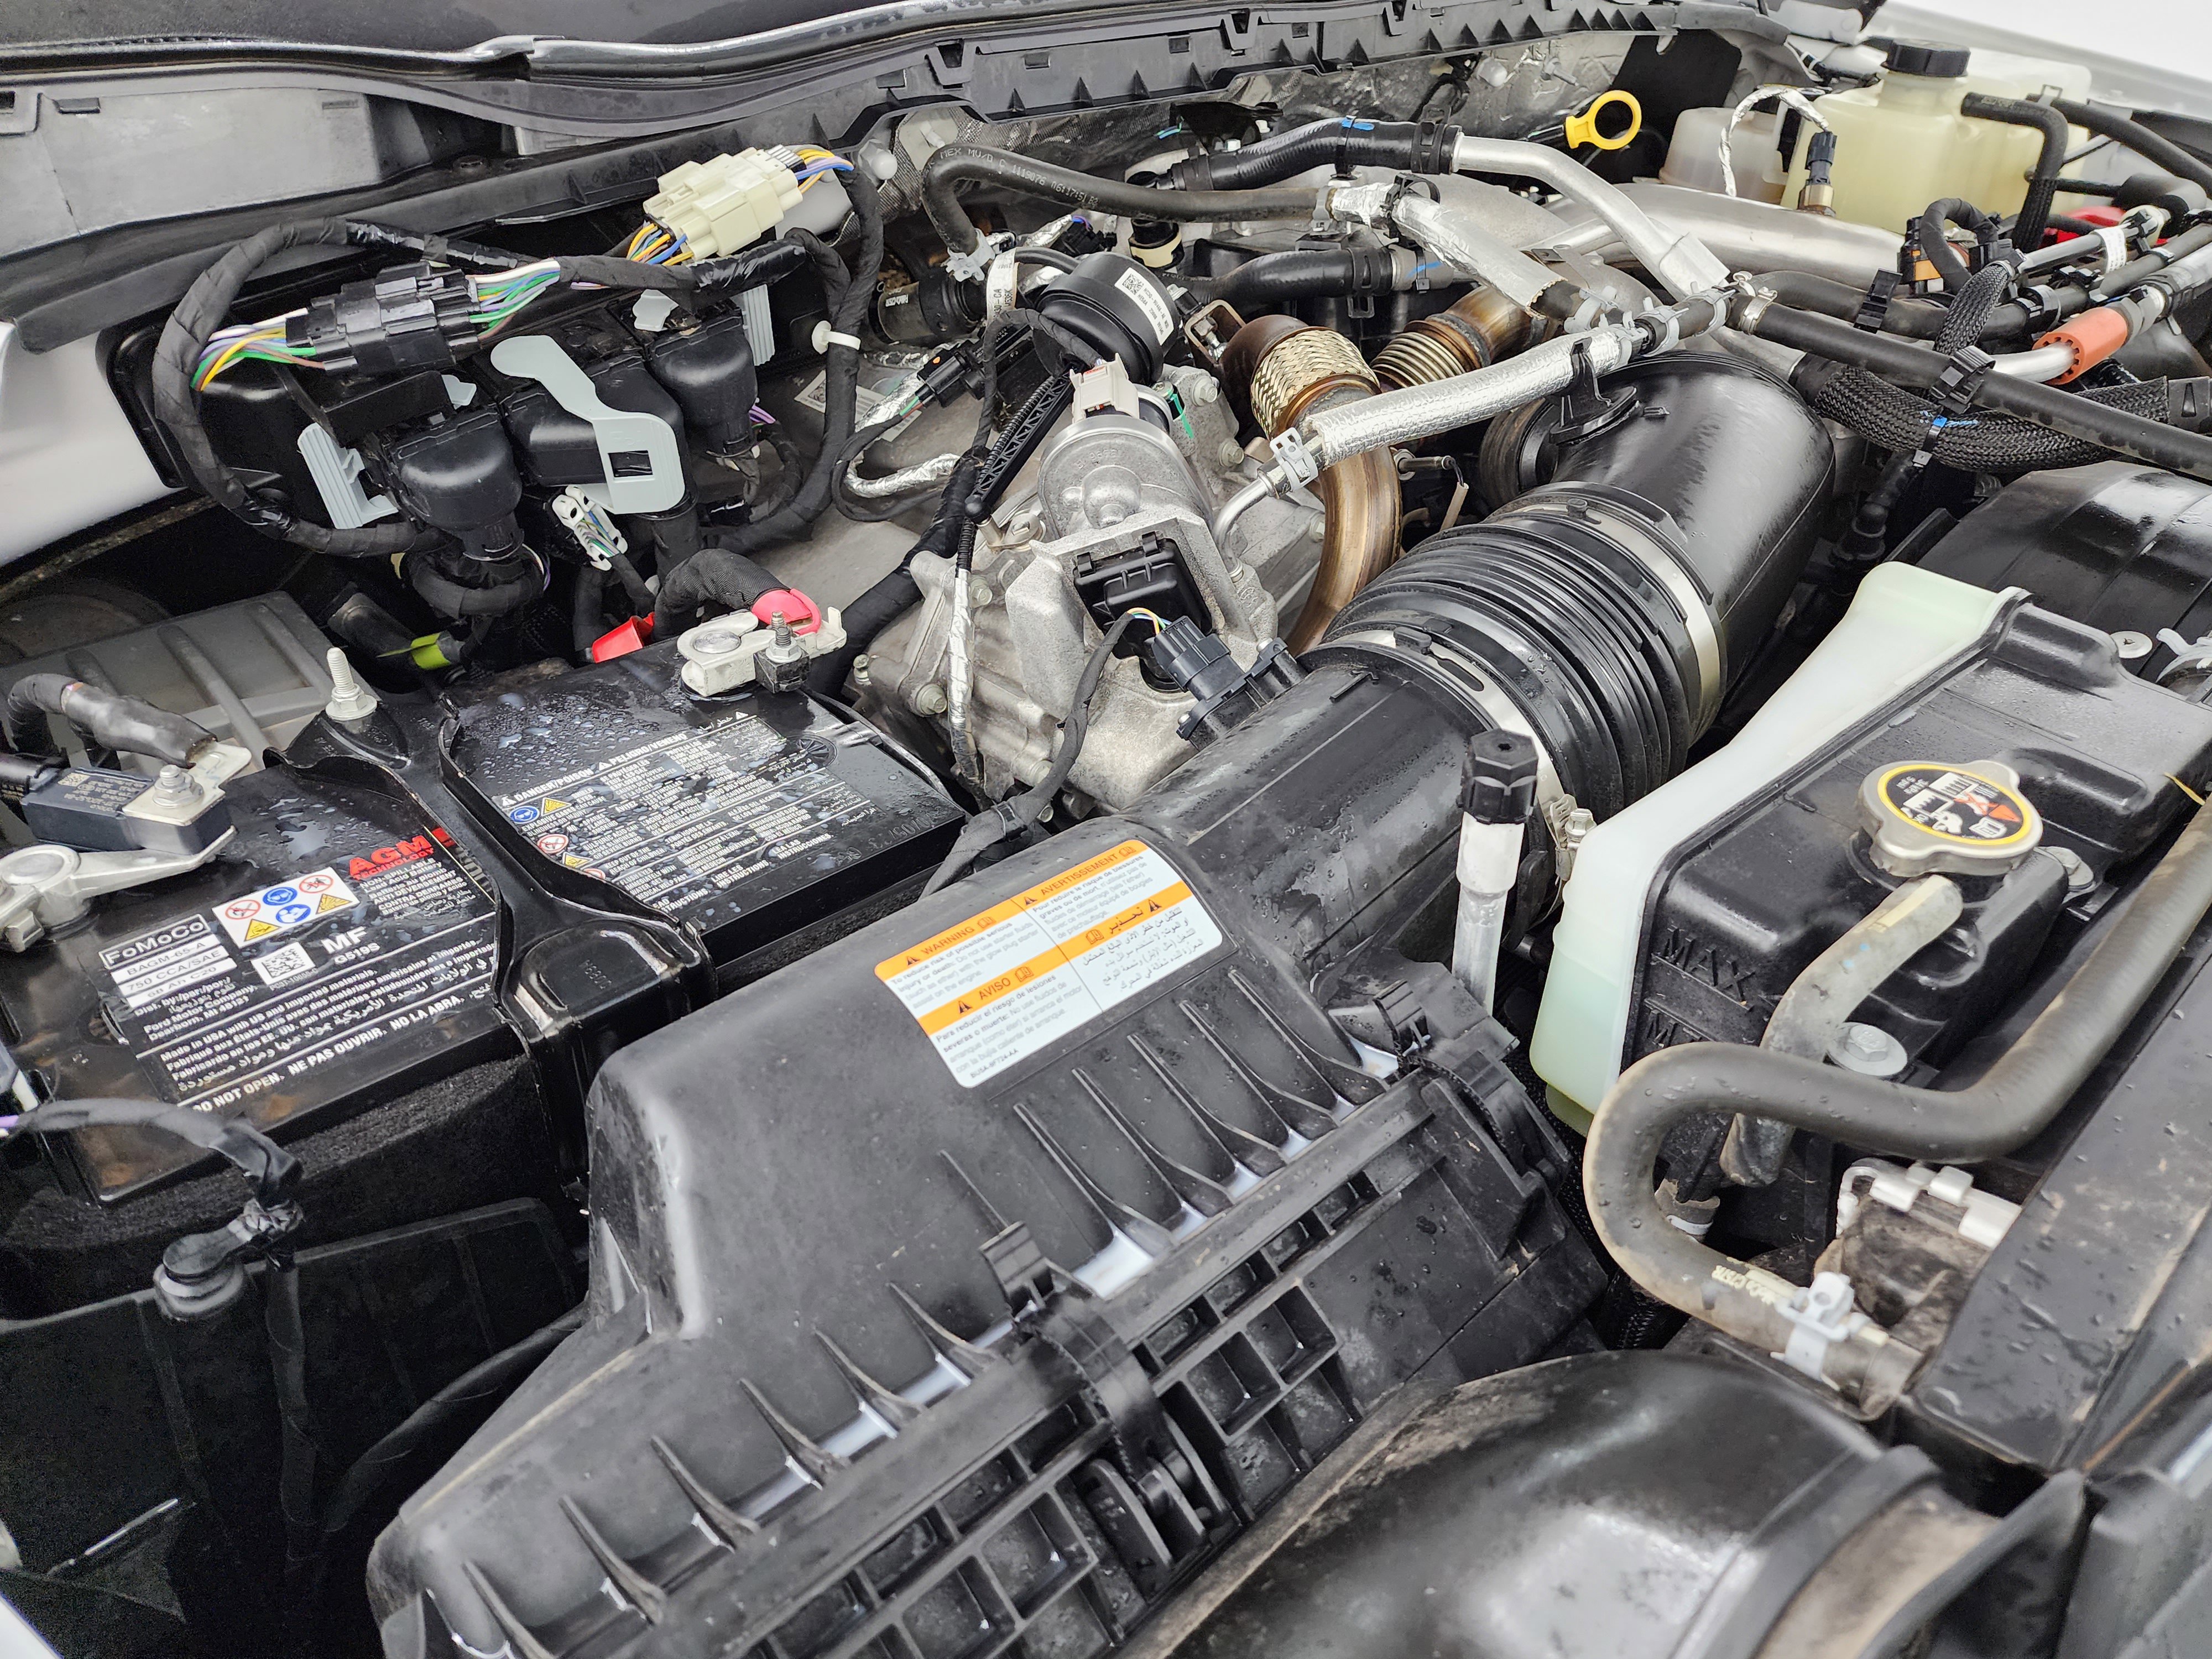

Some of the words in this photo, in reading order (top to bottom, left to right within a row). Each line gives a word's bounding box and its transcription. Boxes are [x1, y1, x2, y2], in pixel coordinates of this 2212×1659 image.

[609, 733, 687, 764] PELIGRO/VENENO
[513, 769, 593, 800] DANGER/POISON
[662, 797, 701, 816] SULFURIQUE
[347, 833, 431, 875] AGM
[771, 846, 788, 854] LEA
[785, 839, 801, 848] LAS
[354, 848, 433, 880] TECHNOLOGY
[364, 880, 387, 893] Lead
[388, 872, 410, 884] Acid
[411, 860, 442, 877] Battery
[608, 863, 630, 873] REACH
[709, 872, 730, 882] LIRE
[726, 865, 744, 874] LES
[715, 860, 772, 887] INSTRUCTIONS.
[1041, 854, 1117, 894] AVERTISSEMENT
[368, 882, 405, 899] Batterie
[406, 877, 418, 886] au
[419, 867, 447, 881] plomb
[374, 892, 396, 904] ANTI
[378, 893, 415, 911] CONTRA
[417, 876, 463, 897] DERRAMES
[420, 890, 441, 902] plomo
[1032, 902, 1050, 912] Pour
[1081, 875, 1103, 888] risque
[1112, 854, 1144, 873] blessures
[1039, 905, 1063, 919] graves
[1126, 865, 1139, 875] pas
[651, 899, 671, 909] EAD
[106, 920, 203, 963] FoMoCo
[322, 926, 368, 954] MF
[334, 940, 380, 966] G519S
[891, 976, 903, 985] To
[902, 963, 930, 979] reduce
[930, 955, 945, 965] risk
[954, 935, 987, 954] possible
[985, 921, 1013, 937] serious
[921, 925, 974, 955] WARNING
[954, 954, 968, 963] Do
[966, 947, 980, 957] not
[979, 942, 993, 950] use
[128, 942, 204, 974] BAGM-65-A
[128, 977, 153, 991] 750
[155, 950, 220, 979] CCA/SAE
[1661, 923, 1756, 1002] MAX
[167, 978, 186, 988] Ah
[189, 967, 217, 980] C20
[976, 977, 1012, 1000] AVISO
[143, 1018, 170, 1033] Ford
[171, 1004, 204, 1022] Motor
[160, 1043, 191, 1061] Made
[190, 1037, 204, 1049] in
[202, 1028, 226, 1044] USA
[225, 1019, 249, 1034] with
[249, 1012, 264, 1024] US
[264, 1003, 285, 1018] and
[285, 985, 328, 1010] imported
[204, 1008, 218, 1018] MI
[935, 1029, 955, 1042] Para
[954, 1014, 984, 1032] reducir
[982, 1008, 992, 1016] el
[990, 996, 1016, 1013] riesgo
[1014, 990, 1026, 999] de
[1025, 974, 1057, 993] lesiones
[942, 1033, 973, 1052] severas
[1008, 1005, 1021, 1016] No
[1021, 999, 1035, 1009] use
[1056, 980, 1068, 990] de
[212, 1086, 243, 1108] NOT
[243, 1068, 285, 1095] OPEN.
[287, 1058, 308, 1075] NE
[306, 1046, 335, 1067] PAS
[389, 1014, 409, 1031] NO
[409, 1006, 429, 1024] LA
